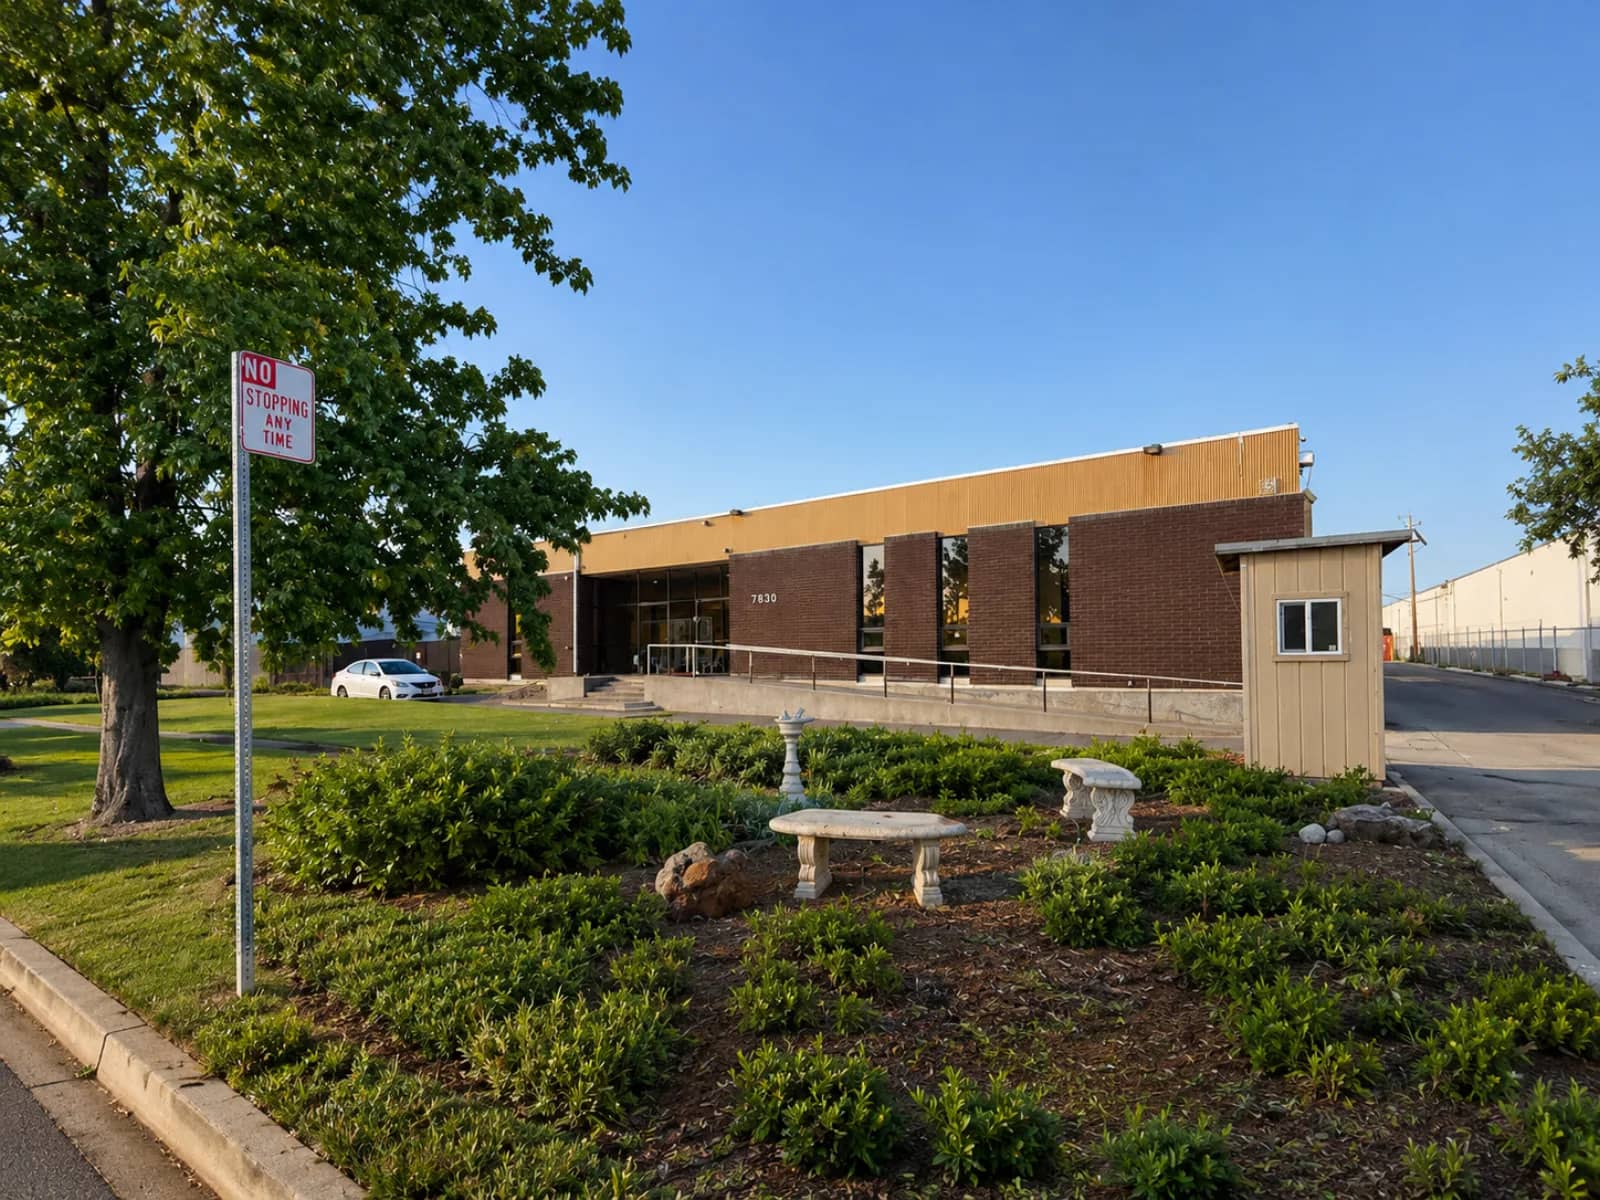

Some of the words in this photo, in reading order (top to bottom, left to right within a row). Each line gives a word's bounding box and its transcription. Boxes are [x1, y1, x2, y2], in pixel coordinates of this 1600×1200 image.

[245, 357, 272, 384] NO
[246, 388, 308, 419] STOPPING
[265, 413, 292, 431] ANY
[263, 430, 293, 449] TIME
[751, 593, 777, 604] 7830
